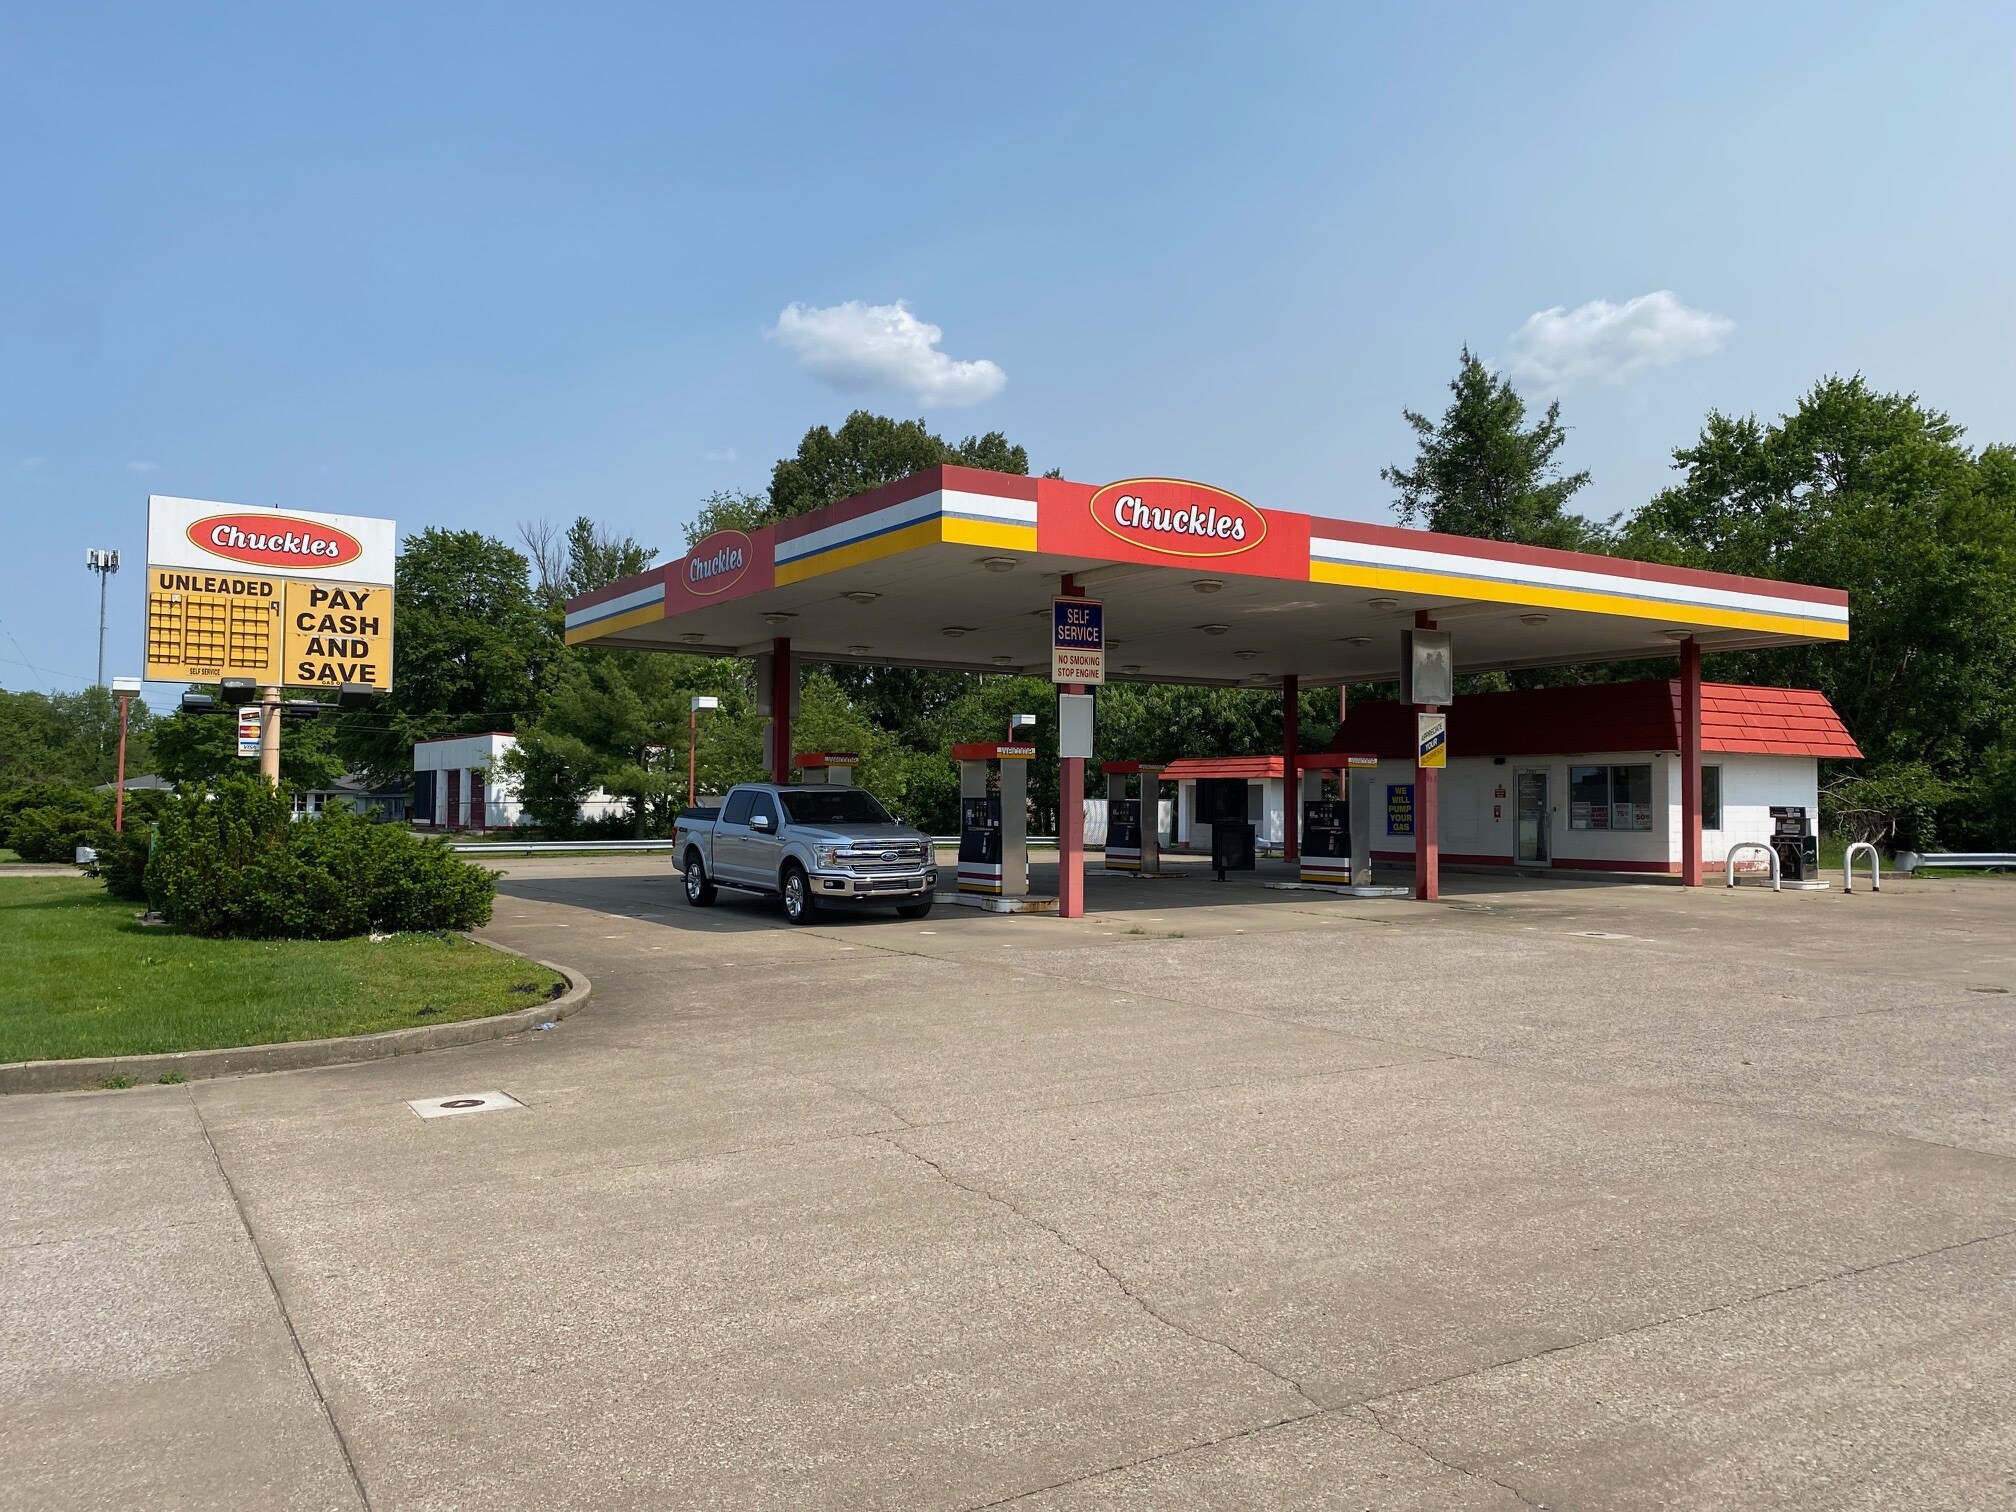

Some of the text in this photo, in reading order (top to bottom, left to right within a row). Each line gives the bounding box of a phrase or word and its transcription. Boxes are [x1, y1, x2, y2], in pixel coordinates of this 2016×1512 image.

[1114, 495, 1246, 541] Chuckles
[211, 525, 340, 558] Chuckles
[689, 546, 743, 583] Chuckles
[160, 573, 273, 597] UNLEADED
[310, 589, 370, 611] PAY
[296, 612, 379, 635] CASH
[1067, 608, 1090, 624] SELF
[1058, 625, 1099, 642] SERVICE
[305, 637, 369, 659] AND
[1058, 654, 1100, 666] NO SMOKING
[202, 668, 220, 676] SERVICE
[298, 662, 377, 683] SAVE
[1057, 668, 1099, 679] STOP ENGINE
[1425, 737, 1438, 751] YOUR
[1395, 787, 1407, 795] WE
[1388, 805, 1412, 813] PUMP
[1390, 814, 1412, 822] YOUR
[1393, 823, 1410, 831] GAS
